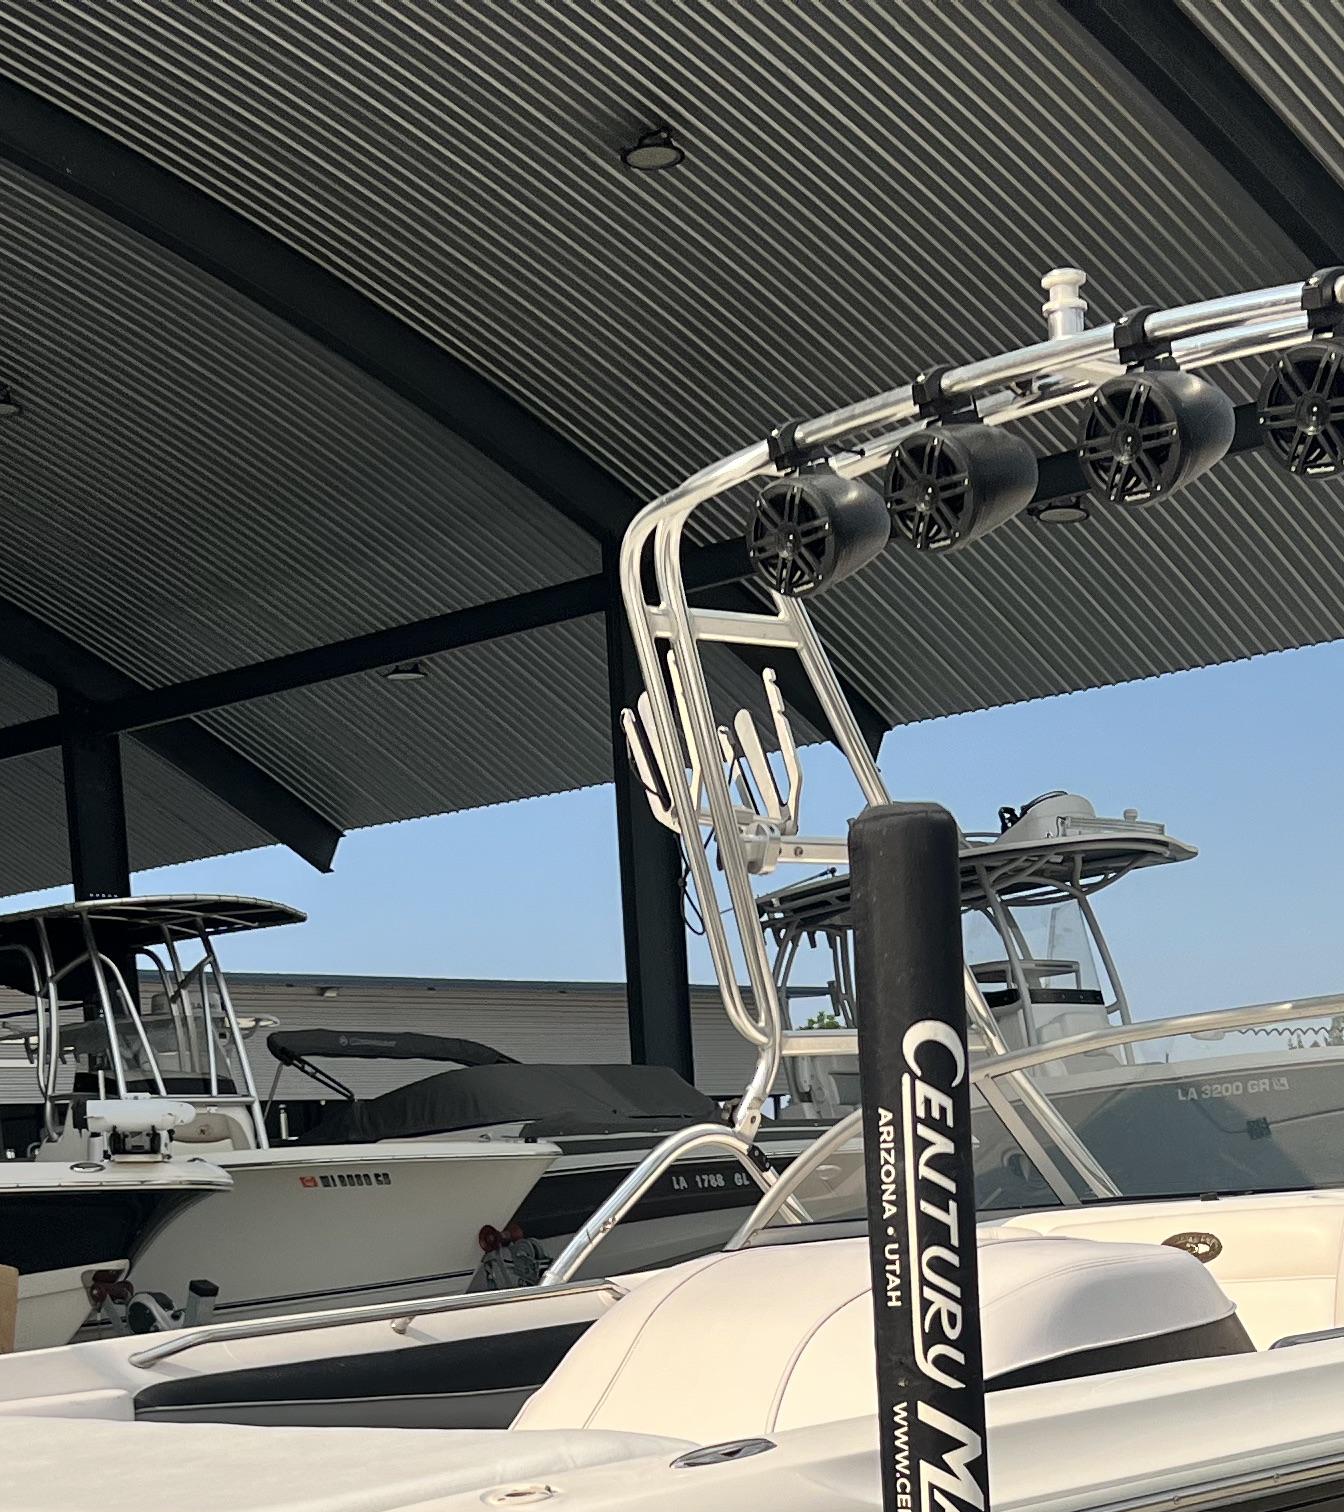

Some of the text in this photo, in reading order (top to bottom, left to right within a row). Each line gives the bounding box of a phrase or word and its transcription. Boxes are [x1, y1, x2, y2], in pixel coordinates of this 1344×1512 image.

[1177, 1087, 1198, 1101] LA
[1201, 1082, 1243, 1098] 3200
[672, 1176, 688, 1190] LA
[877, 1106, 902, 1307] ARIZONA UTAH
[902, 1019, 966, 1389] CENTURY
